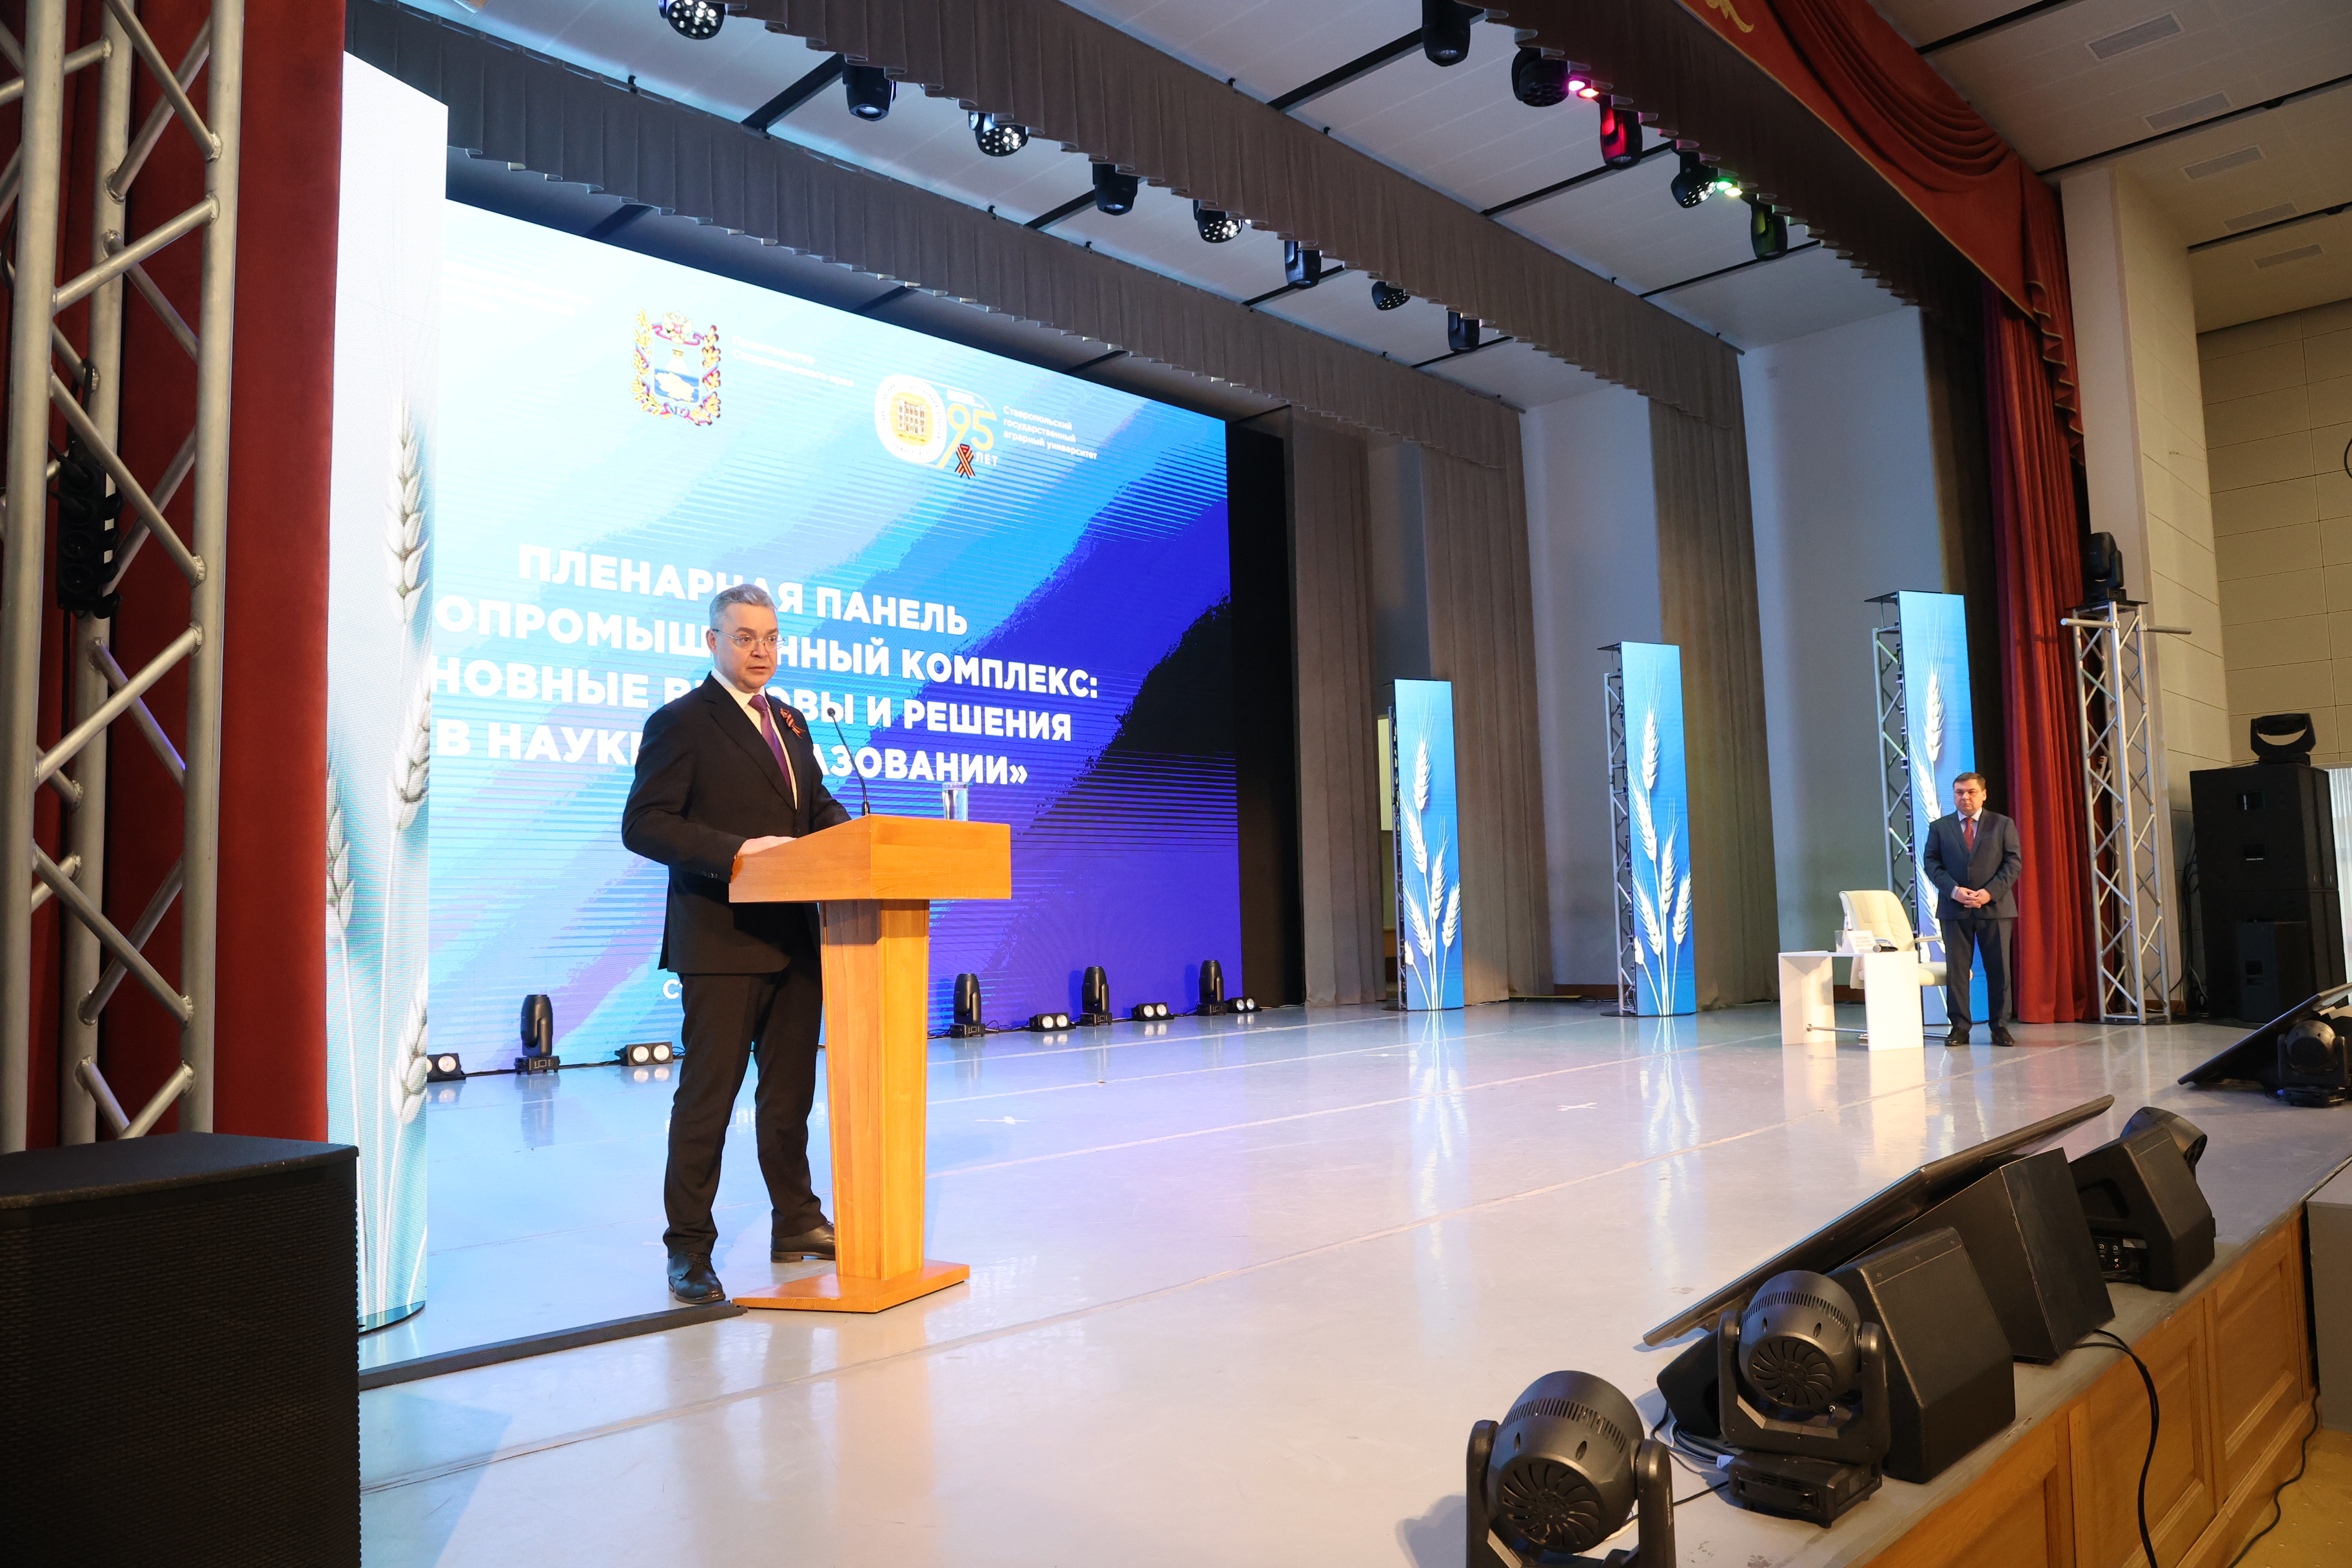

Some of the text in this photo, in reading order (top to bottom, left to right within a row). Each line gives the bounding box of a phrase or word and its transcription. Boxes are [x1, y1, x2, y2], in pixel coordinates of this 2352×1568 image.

[936, 403, 997, 469] 95
[1003, 406, 1073, 431] Ставропольский
[1003, 418, 1076, 443] государственный
[975, 451, 998, 467] ЛЕТ
[1003, 430, 1098, 460] аграрный университет
[816, 586, 968, 636] ПАНЕЛЬ
[435, 594, 1098, 699] ОПРОМЫШННЫЙ КОМПЛЕКС:
[436, 718, 471, 756] В
[867, 696, 892, 728] И
[903, 698, 1072, 742] РЕШЕНИЯ
